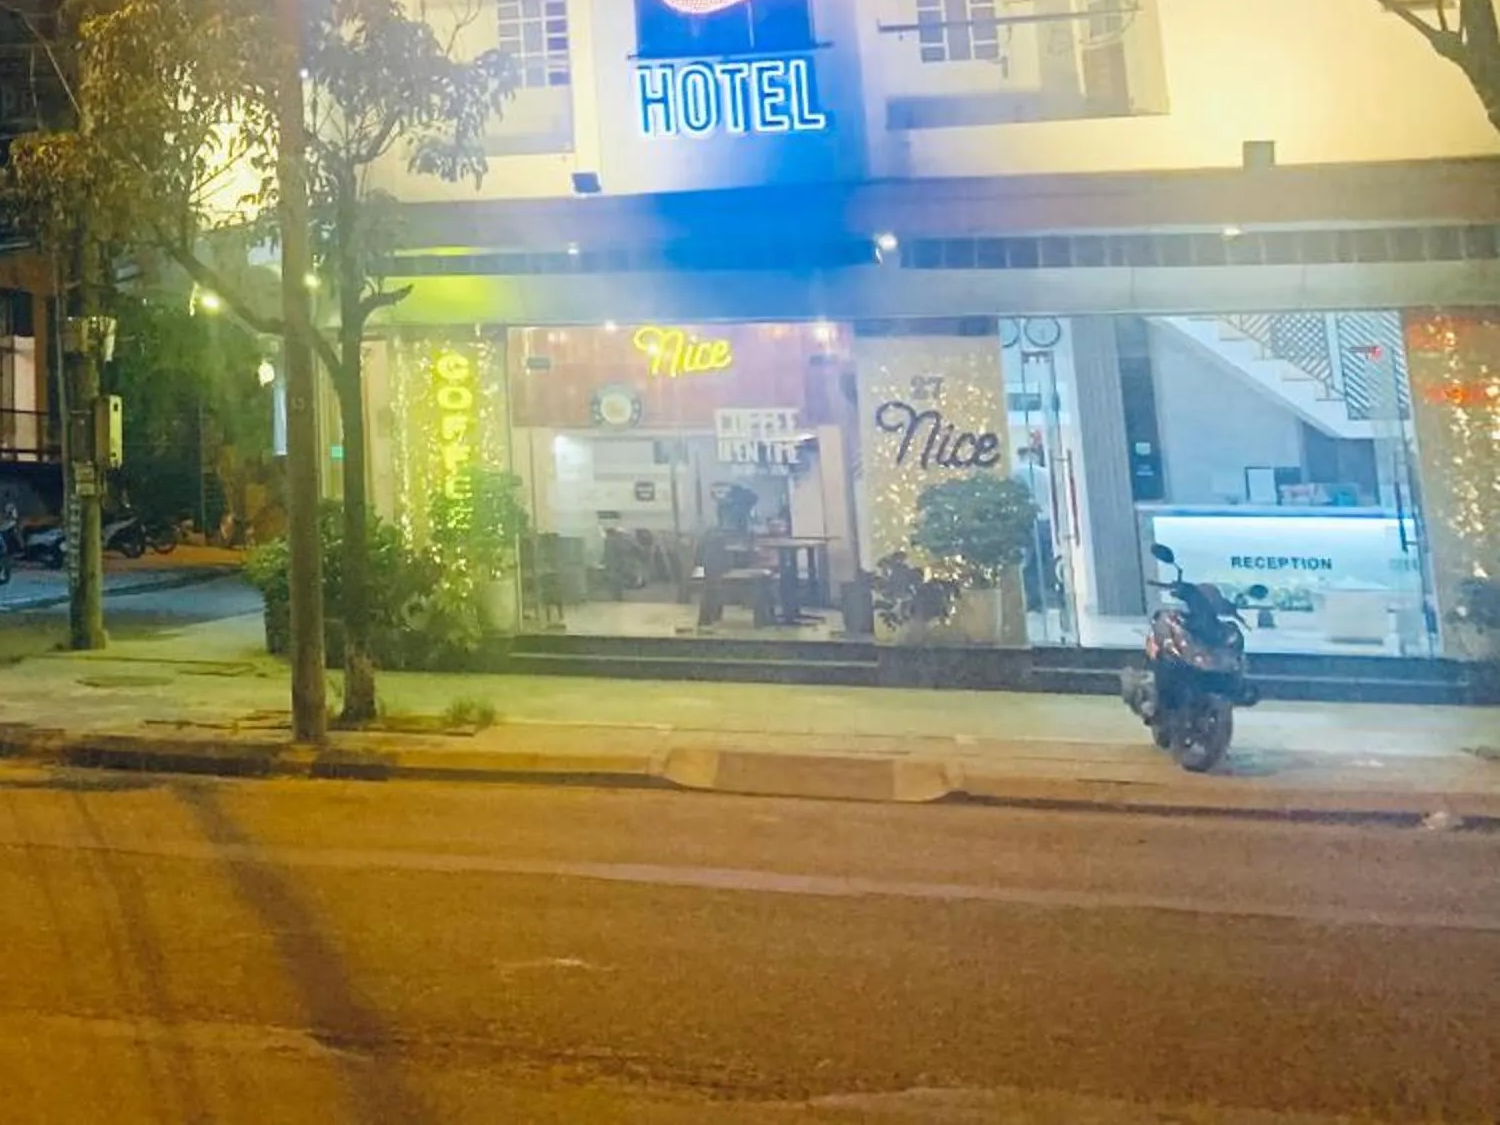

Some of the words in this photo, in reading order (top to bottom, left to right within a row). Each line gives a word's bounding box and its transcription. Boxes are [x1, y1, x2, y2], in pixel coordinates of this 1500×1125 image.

[635, 59, 828, 138] HOTEL
[633, 326, 733, 378] Nice
[876, 401, 1001, 470] Nice
[1230, 555, 1333, 571] RECEPTION
